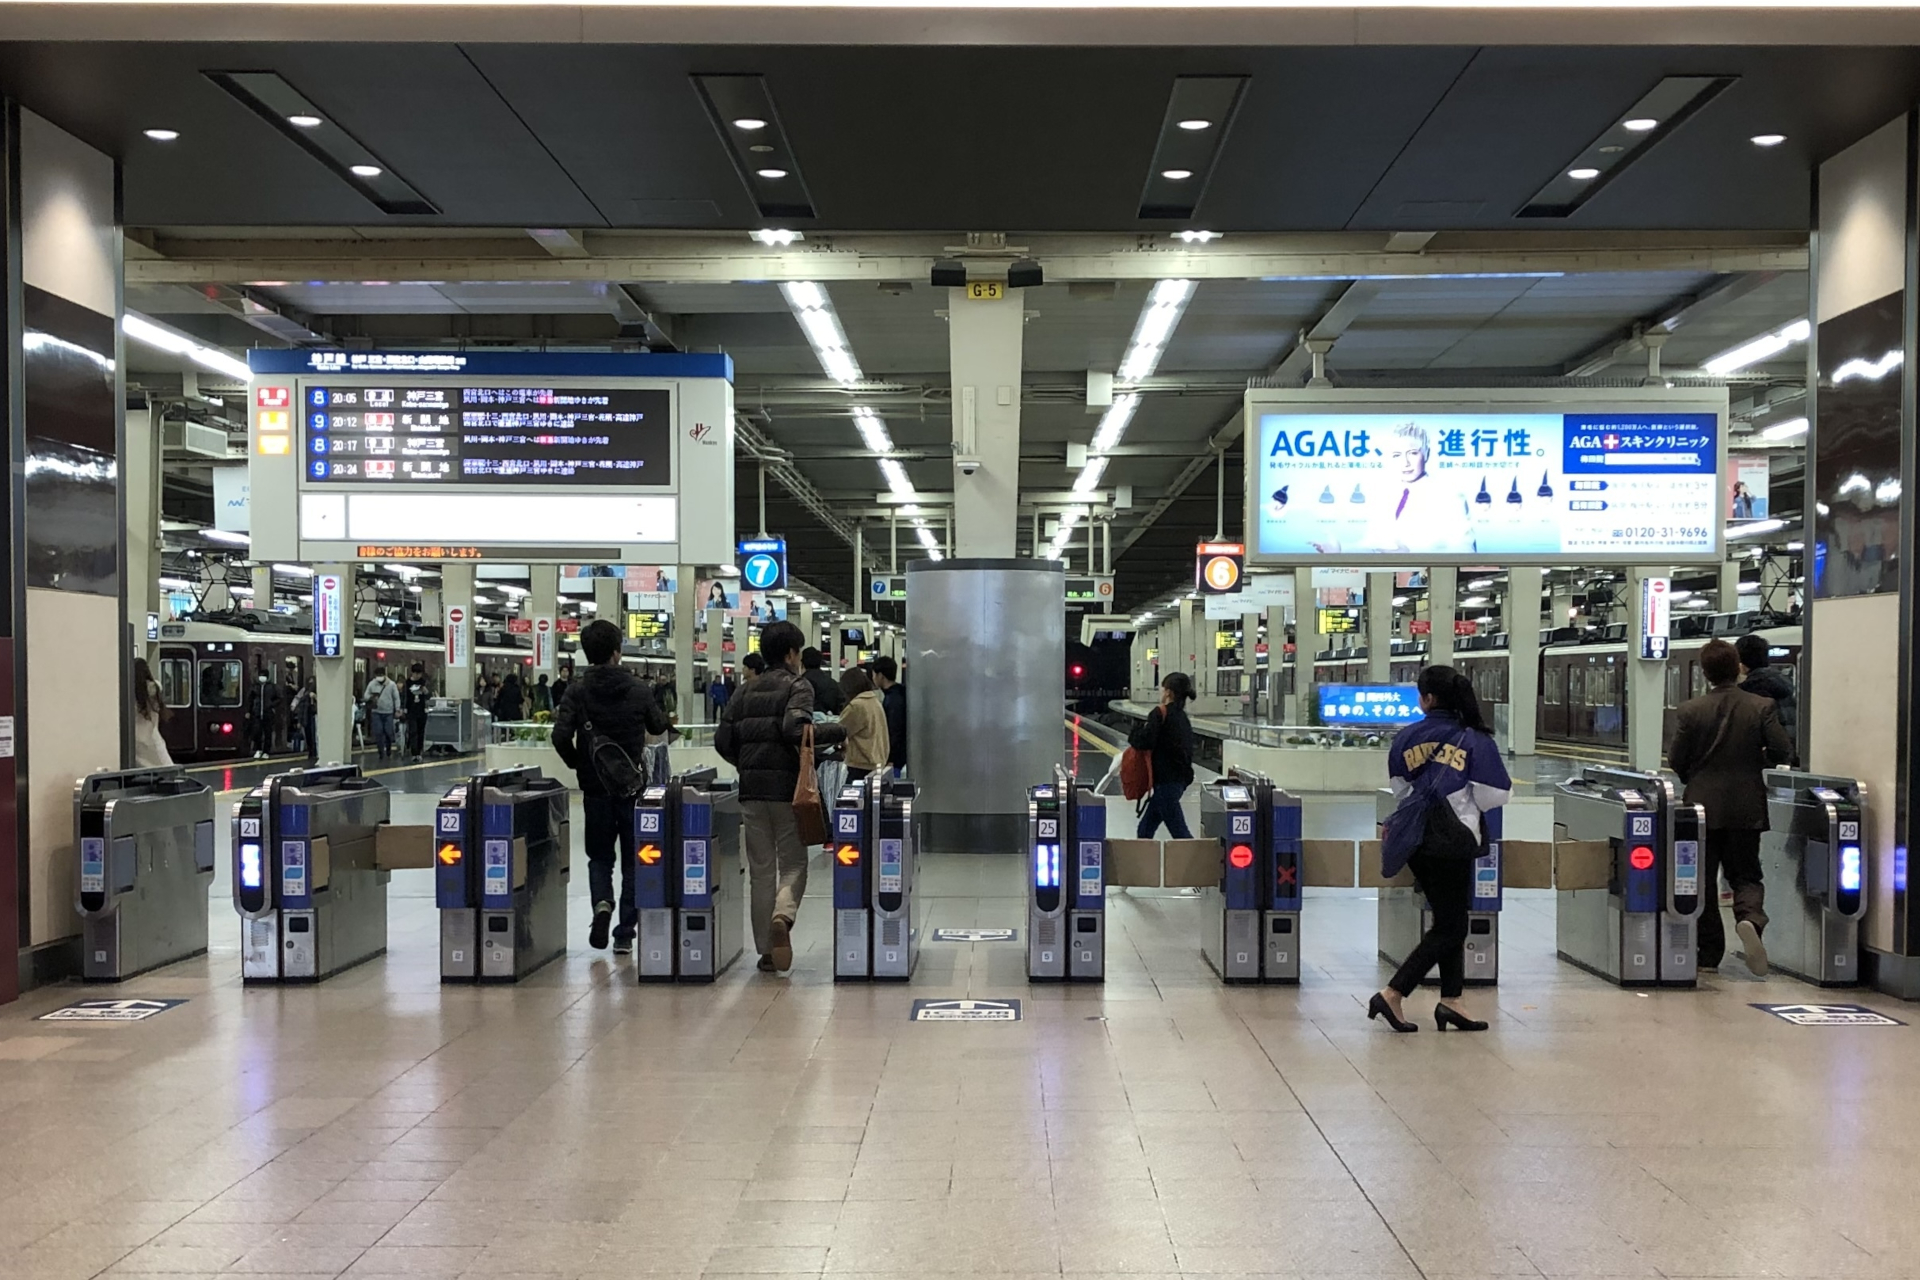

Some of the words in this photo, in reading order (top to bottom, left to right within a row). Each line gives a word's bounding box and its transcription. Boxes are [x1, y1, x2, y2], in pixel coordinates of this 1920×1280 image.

[973, 284, 997, 296] G-5
[314, 391, 324, 404] 8
[332, 393, 357, 403] 20:05
[314, 415, 324, 428] 9
[333, 417, 357, 427] 20:12
[314, 439, 325, 451] 8
[333, 440, 357, 451] 20:17
[1270, 430, 1383, 457] AGAは、
[1438, 429, 1545, 457] 進行性。
[1569, 435, 1602, 448] AGA
[1620, 436, 1710, 448] スキンクリニック
[314, 462, 325, 475] 9
[333, 464, 357, 475] 20:24
[1625, 527, 1707, 538] 0120-31-9696
[752, 559, 770, 584] 7
[1212, 561, 1230, 587] 6
[243, 821, 257, 835] 21
[443, 816, 458, 829] 22
[643, 816, 657, 829] 23
[841, 817, 855, 830] 24
[1041, 822, 1055, 835] 25
[1235, 818, 1249, 832] 26
[1635, 819, 1650, 832] 28
[1841, 824, 1856, 837] 29
